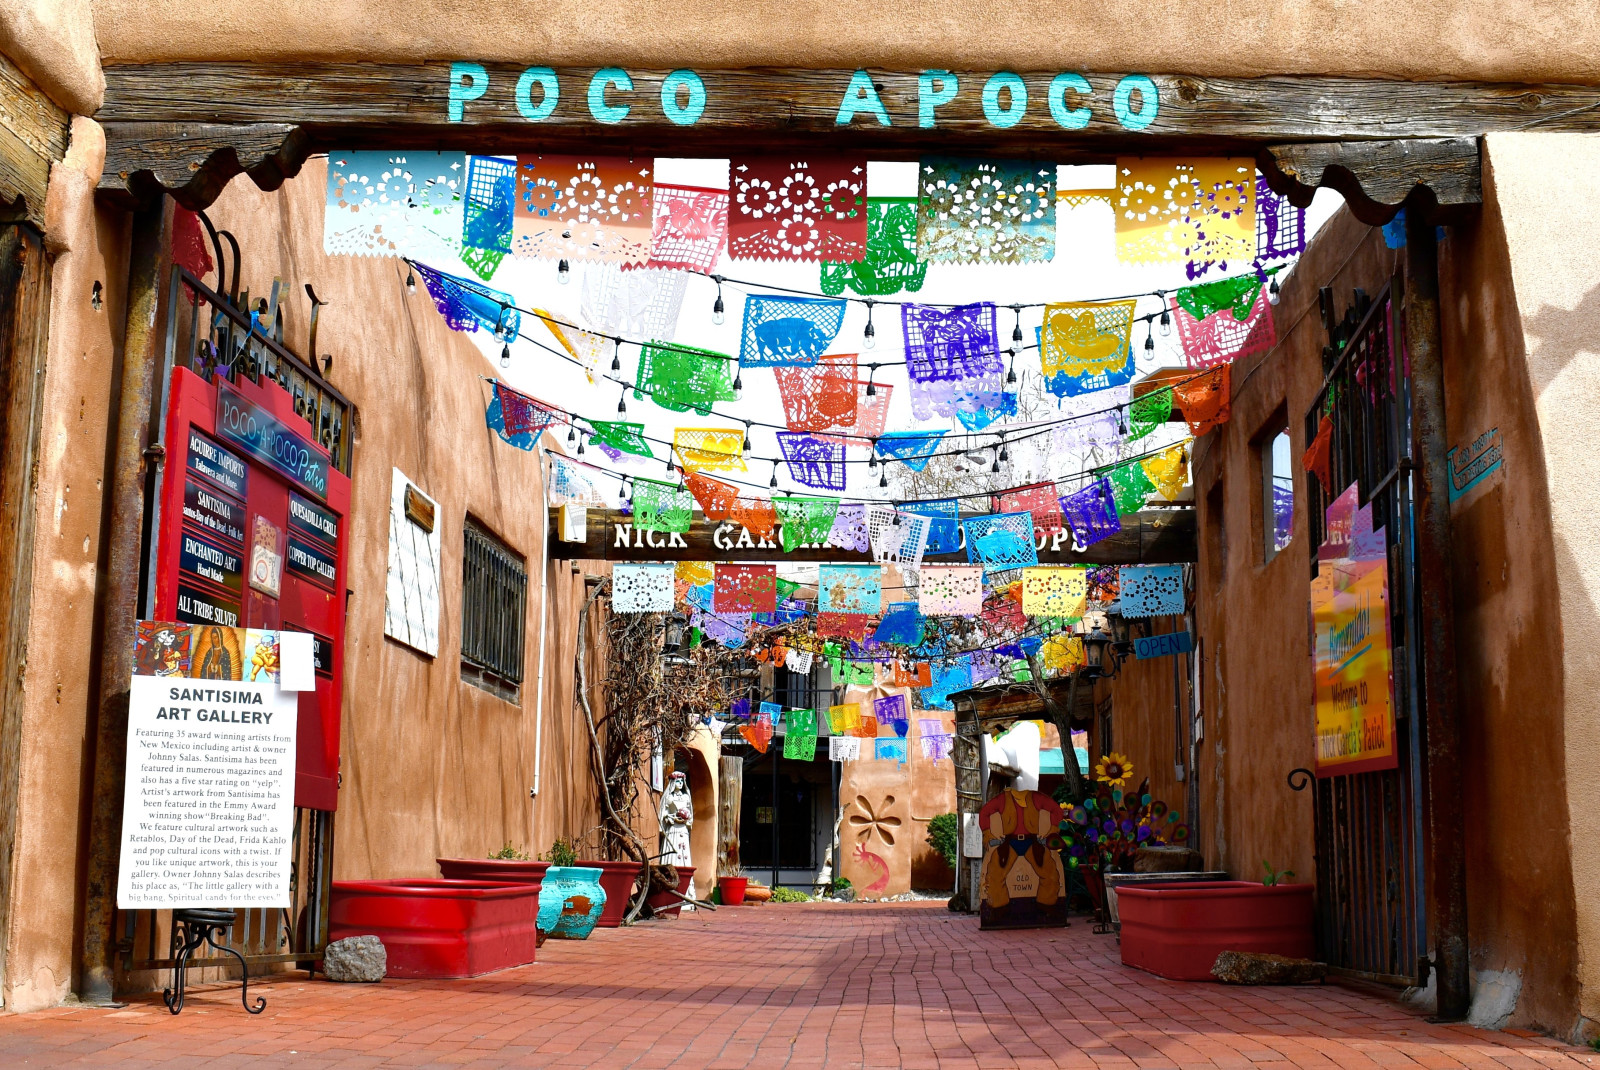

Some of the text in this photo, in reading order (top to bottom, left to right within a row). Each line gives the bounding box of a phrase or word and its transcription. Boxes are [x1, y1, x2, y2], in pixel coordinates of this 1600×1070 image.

[448, 62, 707, 125] POCO
[224, 401, 325, 492] POCO-A-POCO Patio
[190, 436, 244, 478] AGUIRRE IMPORTS
[195, 458, 215, 479] Talavera
[216, 472, 225, 483] and
[198, 491, 230, 519] SANTISIMA
[290, 500, 337, 538] QUESADILLA GRILL
[185, 538, 223, 567] ENCHANTED
[223, 554, 236, 572] ART
[288, 545, 336, 580] COPPER TOP GALLERY
[197, 563, 224, 583] Hand Made
[178, 595, 237, 628] ALL TRIBE SILVER
[1139, 634, 1181, 657] OPEN
[169, 687, 263, 705] SANTISIMA
[1331, 681, 1368, 714] Welcome to
[155, 706, 273, 724] ART GALLERY
[136, 728, 174, 739] Featuring
[176, 729, 185, 737] 35
[188, 731, 211, 739] award
[215, 733, 245, 742] winning
[274, 734, 291, 742] from
[1337, 721, 1362, 756] Garcia's
[1364, 714, 1385, 751] Patio!
[140, 740, 157, 748] New
[161, 740, 190, 749] Mexico
[193, 742, 229, 752] including
[148, 752, 176, 762] Johnny
[205, 754, 242, 763] Santisima
[260, 756, 277, 764] been
[142, 763, 173, 772] featured
[176, 764, 183, 772] in
[227, 767, 266, 776] magazines
[141, 775, 156, 783] also
[160, 776, 172, 784] has
[182, 776, 196, 784] five
[216, 779, 238, 787] rating
[173, 788, 204, 796] artwork
[207, 789, 225, 797] from
[228, 789, 265, 798] Santisima
[268, 790, 280, 798] has
[144, 799, 162, 807] been
[165, 799, 196, 807] featured
[199, 800, 206, 808] in
[209, 800, 221, 808] the
[224, 801, 247, 810] Emmy
[149, 811, 181, 821] winning
[140, 822, 152, 830] We
[155, 822, 182, 831] feature
[185, 823, 215, 831] cultural
[218, 824, 248, 832] artwork
[251, 824, 267, 832] such
[170, 834, 185, 844] Day
[187, 834, 197, 842] of
[199, 835, 211, 843] the
[240, 835, 260, 843] Frida
[263, 836, 286, 844] Kahlo
[133, 846, 147, 854] and
[150, 848, 165, 856] pop
[168, 846, 197, 854] cultural
[274, 847, 281, 855] If
[153, 858, 167, 866] like
[170, 858, 196, 868] unique
[236, 858, 249, 866] this
[194, 870, 220, 879] Johnny
[246, 870, 280, 878] describes
[1016, 874, 1030, 882] OLD
[131, 881, 143, 889] his
[146, 881, 166, 891] place
[206, 881, 224, 889] little
[227, 882, 251, 890] gallery
[129, 893, 142, 902] big
